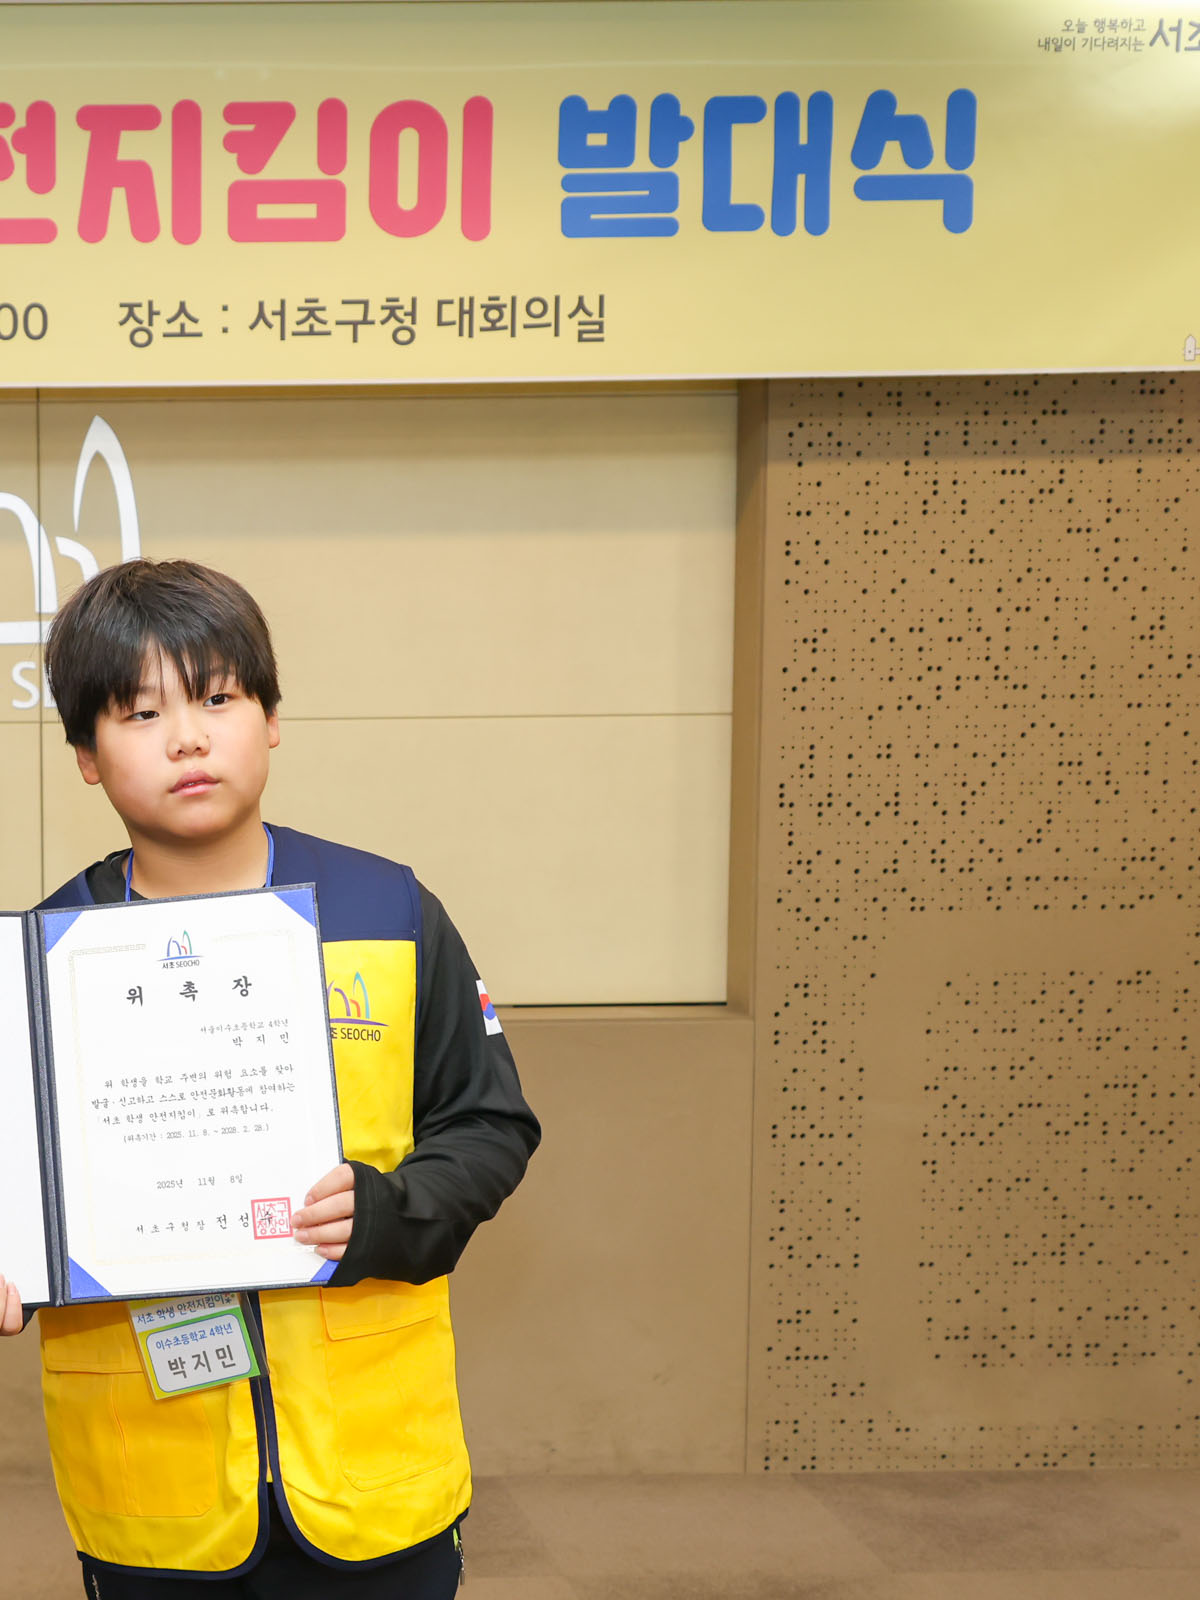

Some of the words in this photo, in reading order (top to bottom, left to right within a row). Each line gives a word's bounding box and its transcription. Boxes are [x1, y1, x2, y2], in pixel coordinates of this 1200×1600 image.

[1061, 18, 1088, 34] 오늘
[1093, 17, 1146, 33] 행복하고
[1037, 36, 1076, 52] 내일이
[1081, 36, 1145, 52] 기다려지는
[557, 87, 978, 240] 발대식
[117, 300, 204, 348] 장소
[248, 296, 419, 346] 서초구청
[436, 294, 606, 343] 대회의실
[176, 960, 200, 968] SEOCHO
[340, 1028, 381, 1041] SEOCHO
[104, 1079, 113, 1089] 위
[121, 1076, 148, 1088] 학생을
[155, 1075, 174, 1085] 학교
[180, 1071, 207, 1083] 주변의
[214, 1069, 233, 1080] 위험
[240, 1065, 268, 1078] 요소를
[275, 1063, 294, 1075] 찾아
[159, 1092, 186, 1103] 스스로
[190, 1085, 254, 1101] 안전문화활동에
[259, 1082, 296, 1095] 참여하는
[126, 1113, 144, 1124] 학생
[220, 1102, 274, 1116] 위촉합니다.
[156, 1178, 184, 1190] 2025년
[197, 1175, 216, 1187] 11월
[137, 1313, 155, 1325] 서초
[156, 1305, 175, 1320] 학생
[177, 1293, 225, 1314] 안전지킴이
[155, 1329, 208, 1350] 이수초등학교
[209, 1322, 233, 1337] 4학년
